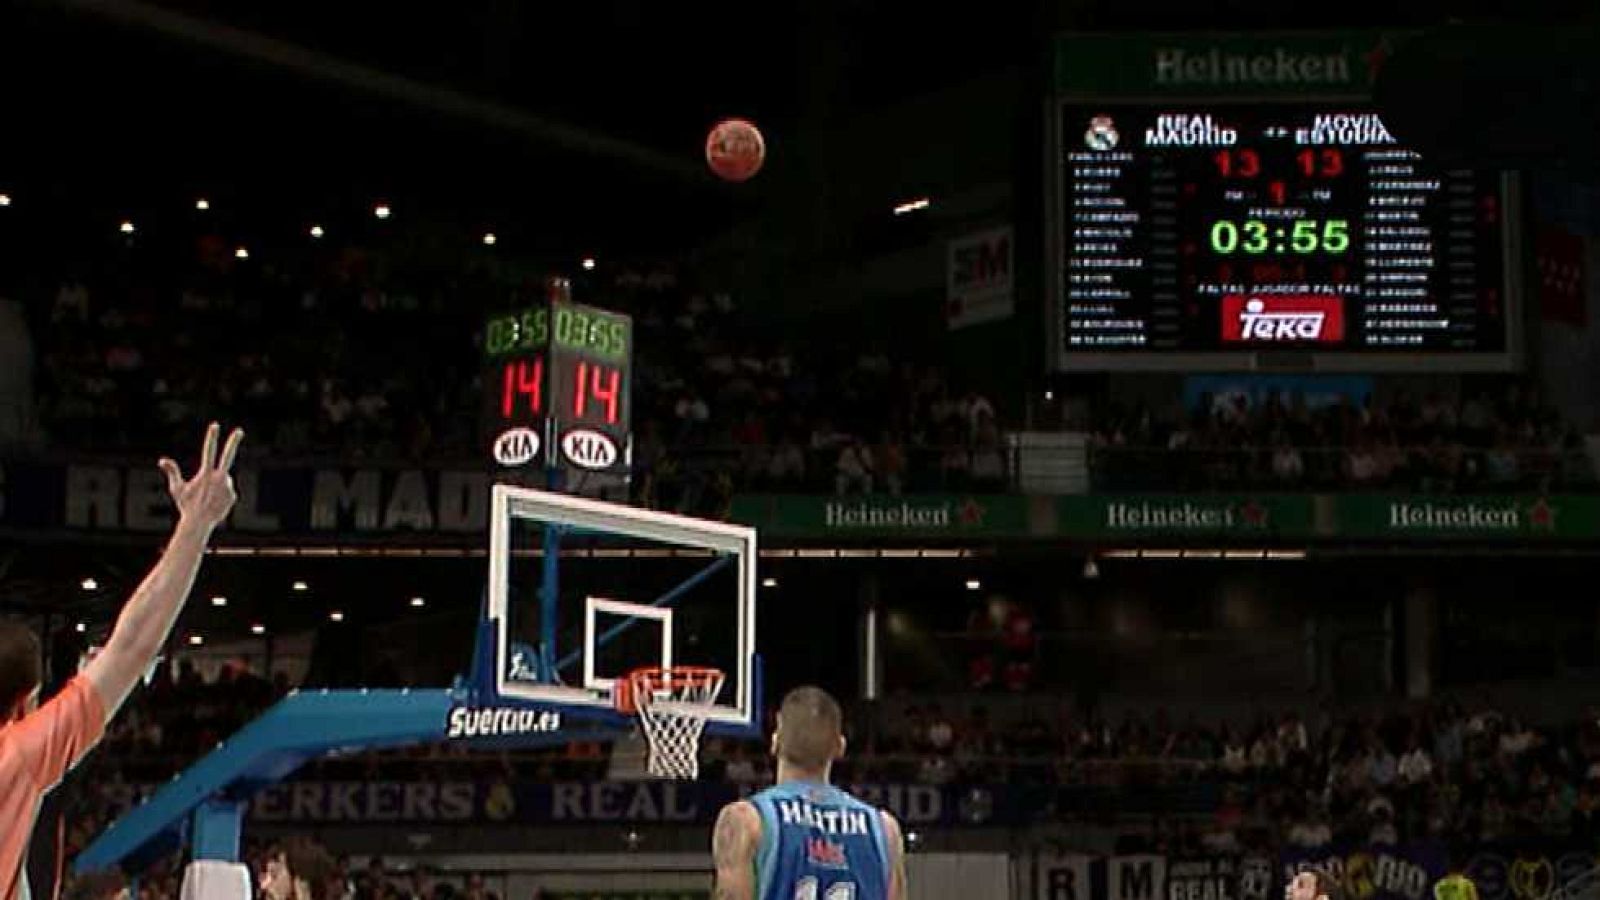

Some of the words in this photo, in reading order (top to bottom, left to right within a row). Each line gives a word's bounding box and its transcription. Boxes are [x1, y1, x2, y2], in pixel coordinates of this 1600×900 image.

[1156, 46, 1350, 83] Heineken
[1213, 150, 1260, 177] 13
[1298, 150, 1343, 177] 13
[1210, 219, 1350, 253] 03:55
[502, 354, 544, 420] 14
[574, 360, 621, 425] 14
[499, 431, 536, 461] KIA
[570, 434, 611, 465] KIA
[64, 464, 282, 530] REL
[311, 468, 488, 531] MAD
[824, 501, 950, 527] Heineken
[1390, 501, 1520, 529] Heineken
[551, 784, 699, 822] REAL
